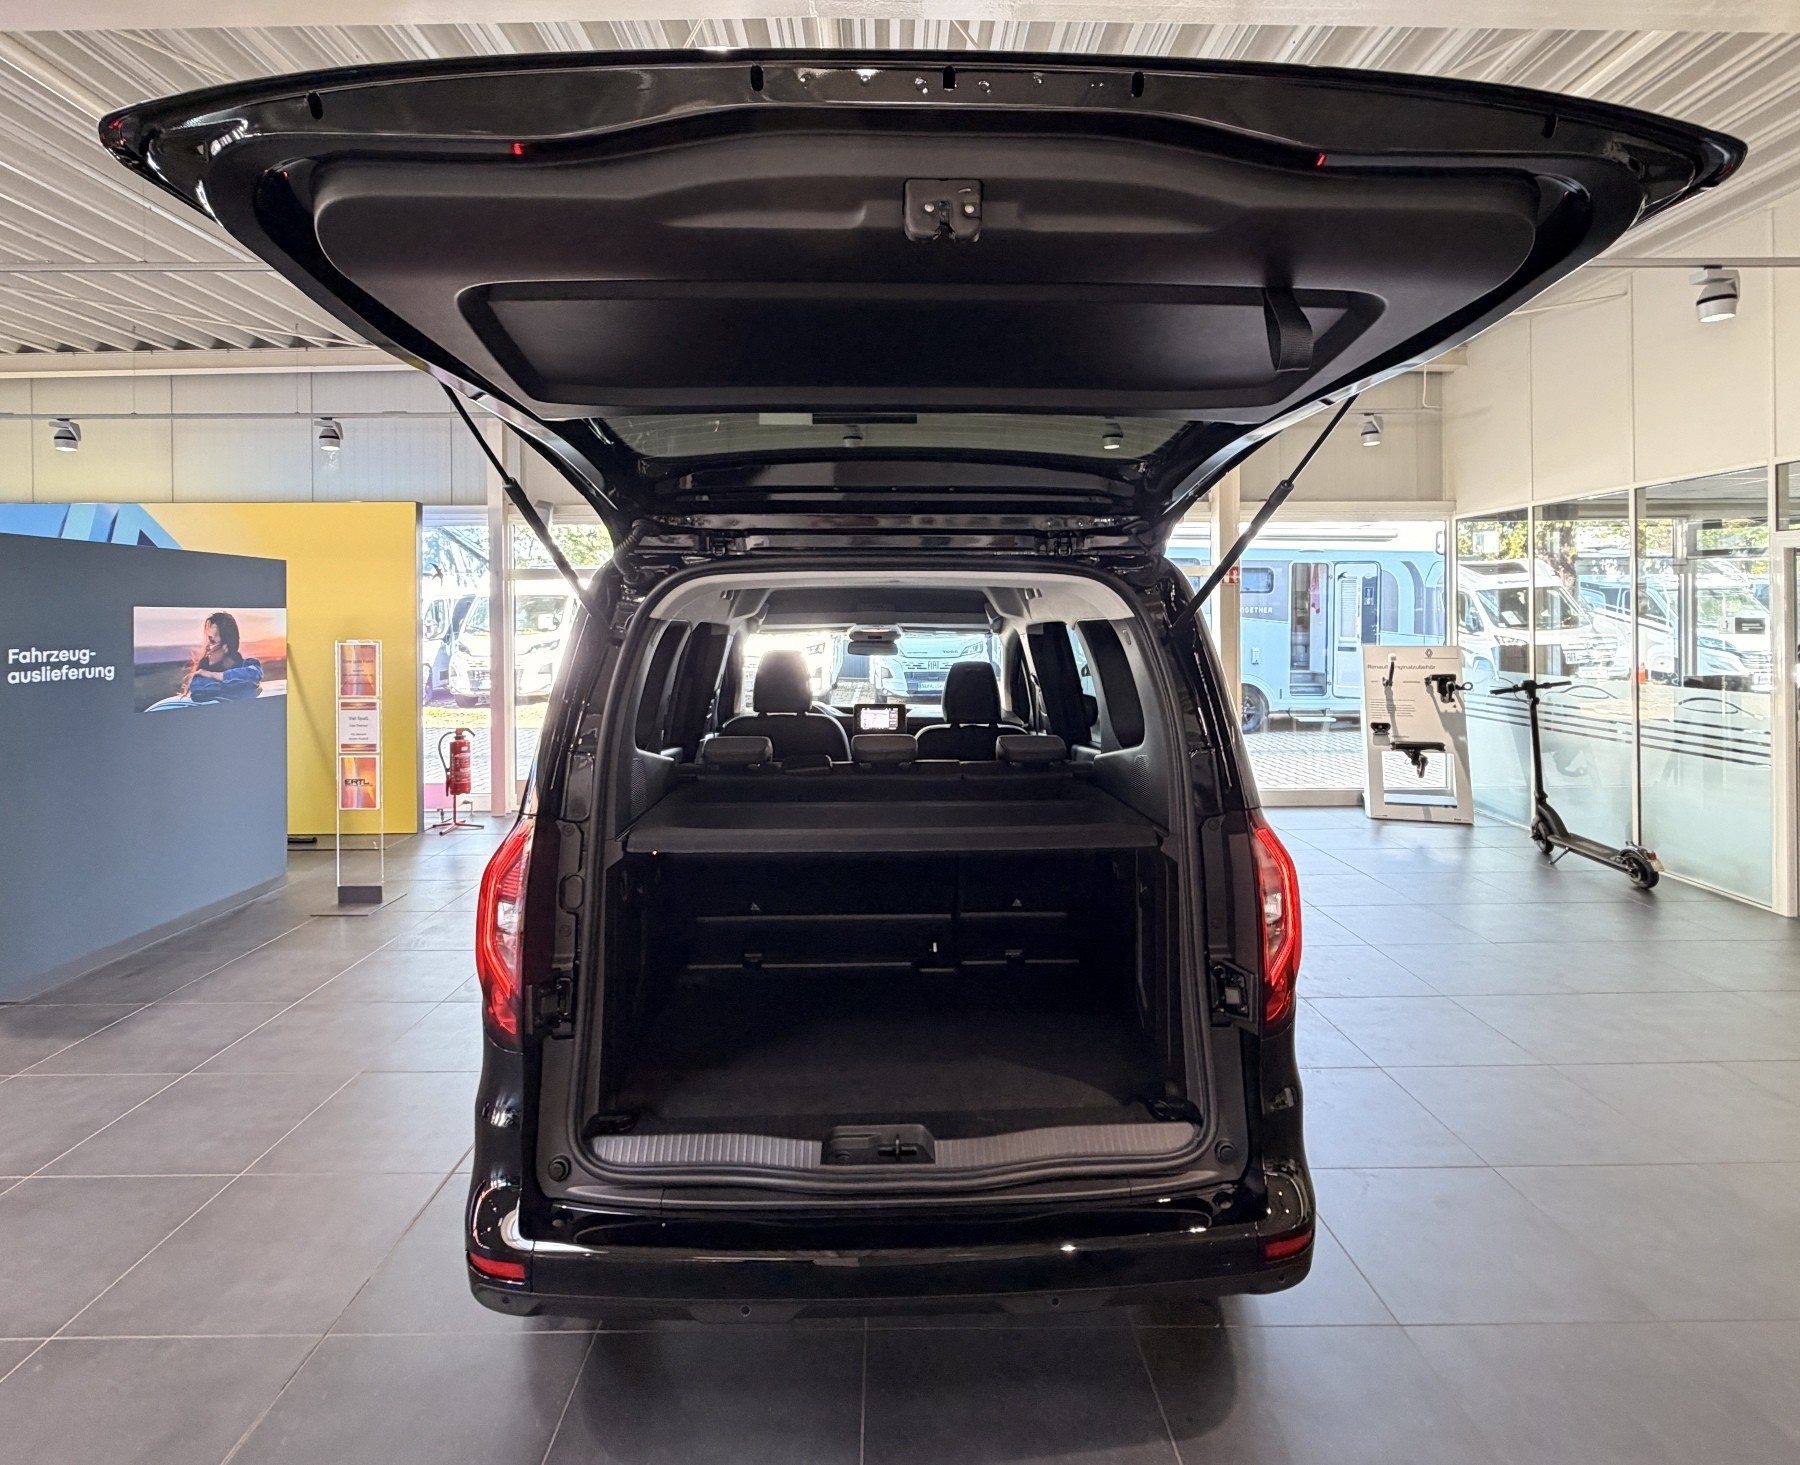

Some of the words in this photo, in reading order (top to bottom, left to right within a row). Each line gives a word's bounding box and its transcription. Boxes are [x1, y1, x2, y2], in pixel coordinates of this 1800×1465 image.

[1240, 606, 1273, 614] OGETHER
[8, 647, 97, 664] Fahrzeug-
[927, 661, 940, 670] FIAT
[7, 665, 115, 684] auslieferung
